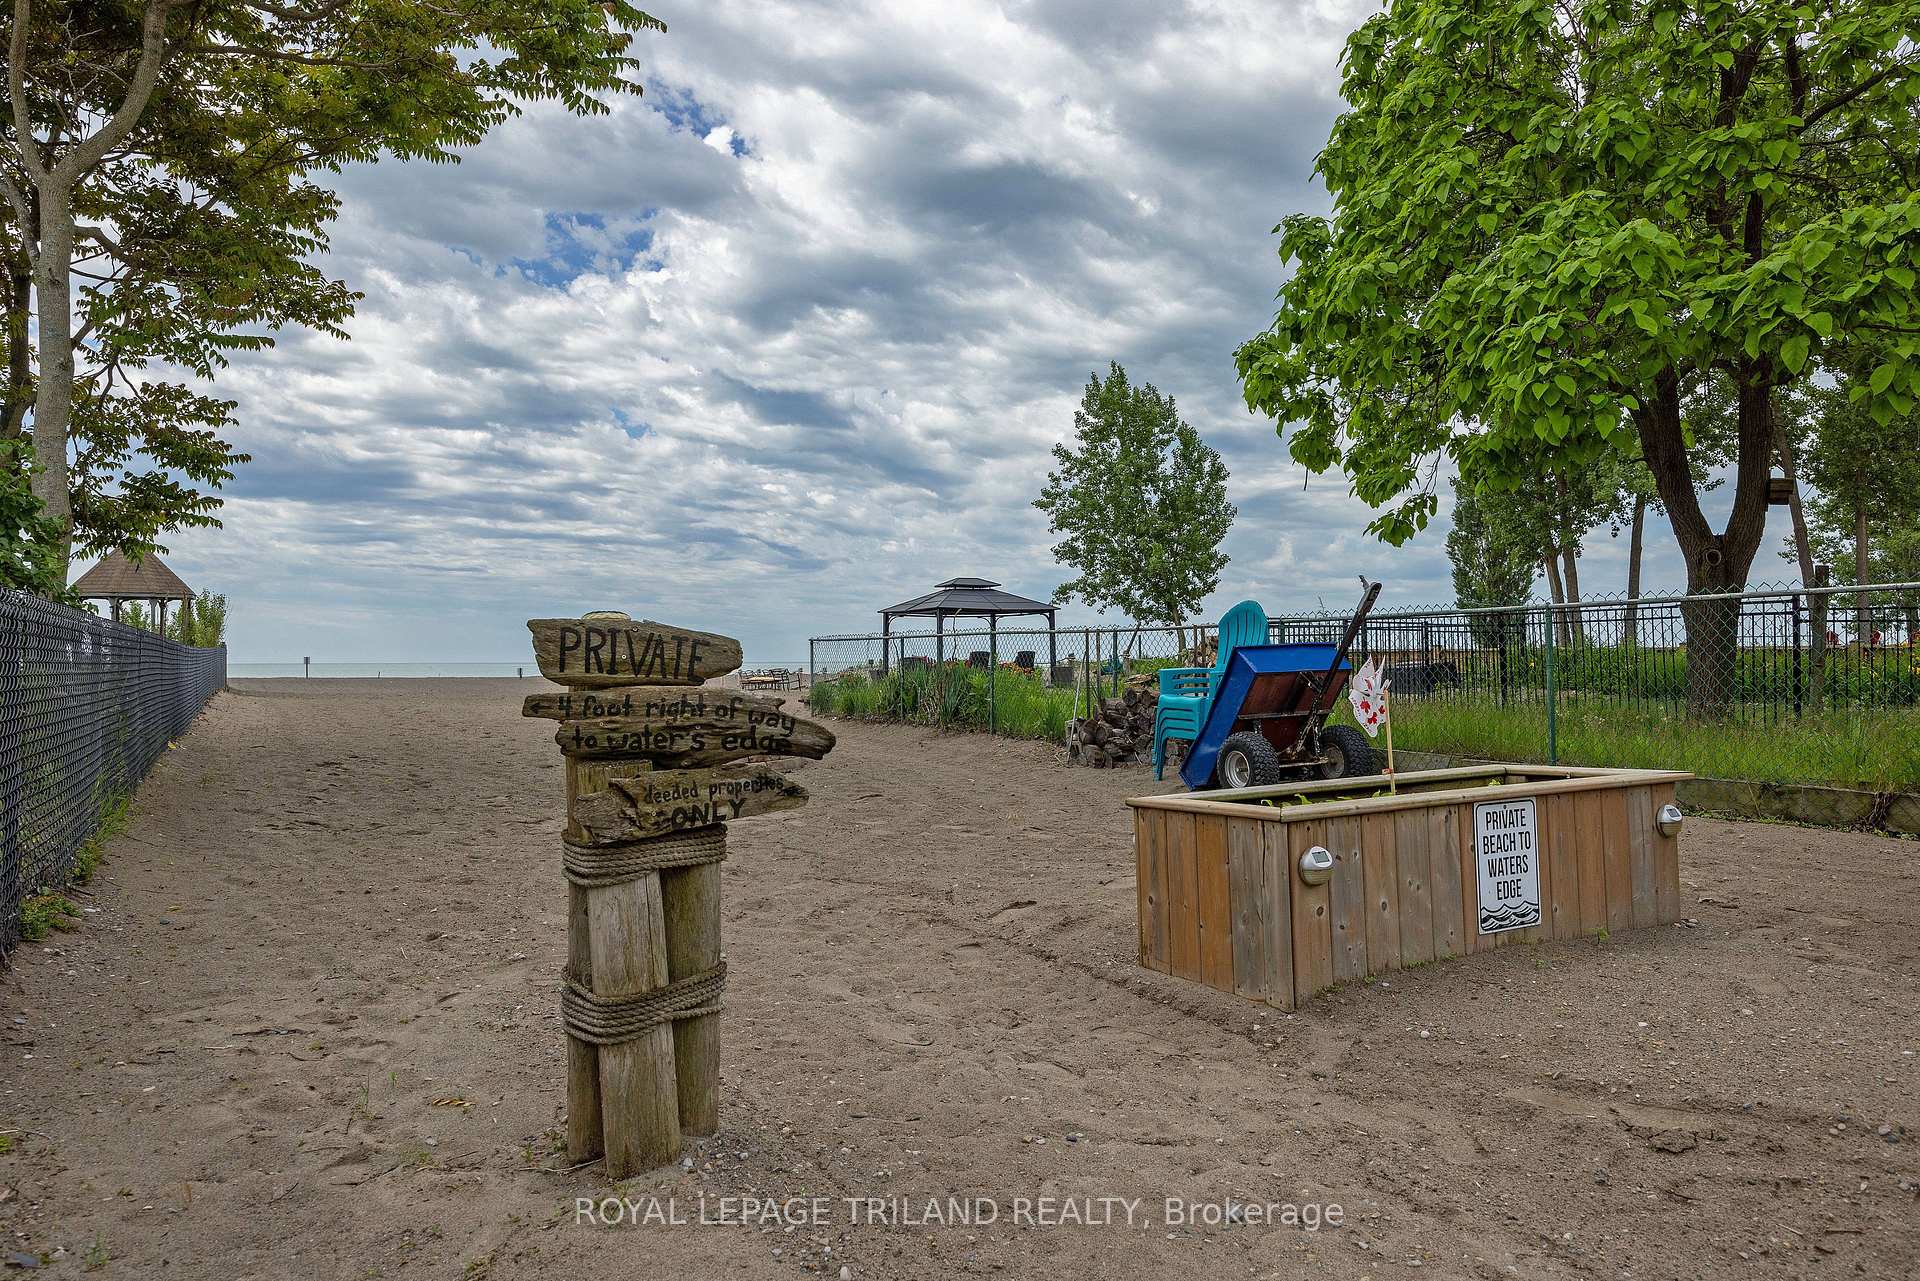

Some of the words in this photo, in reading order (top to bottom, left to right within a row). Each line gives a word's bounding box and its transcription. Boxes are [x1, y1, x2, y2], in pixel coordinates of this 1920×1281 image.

[559, 627, 710, 682] PRIVATE
[559, 696, 572, 717] 4
[583, 696, 634, 719] foot
[646, 694, 707, 721] right
[714, 698, 743, 719] of
[748, 711, 796, 737] way
[572, 725, 598, 749] to
[606, 724, 705, 751] water's
[645, 781, 699, 804] deeded
[671, 798, 746, 828] ONLY
[1486, 808, 1527, 831] PRIVATE
[1483, 832, 1517, 855] BEACH
[1518, 831, 1531, 851] TO
[1488, 854, 1529, 878] WATERS
[1496, 879, 1523, 900] EDGE
